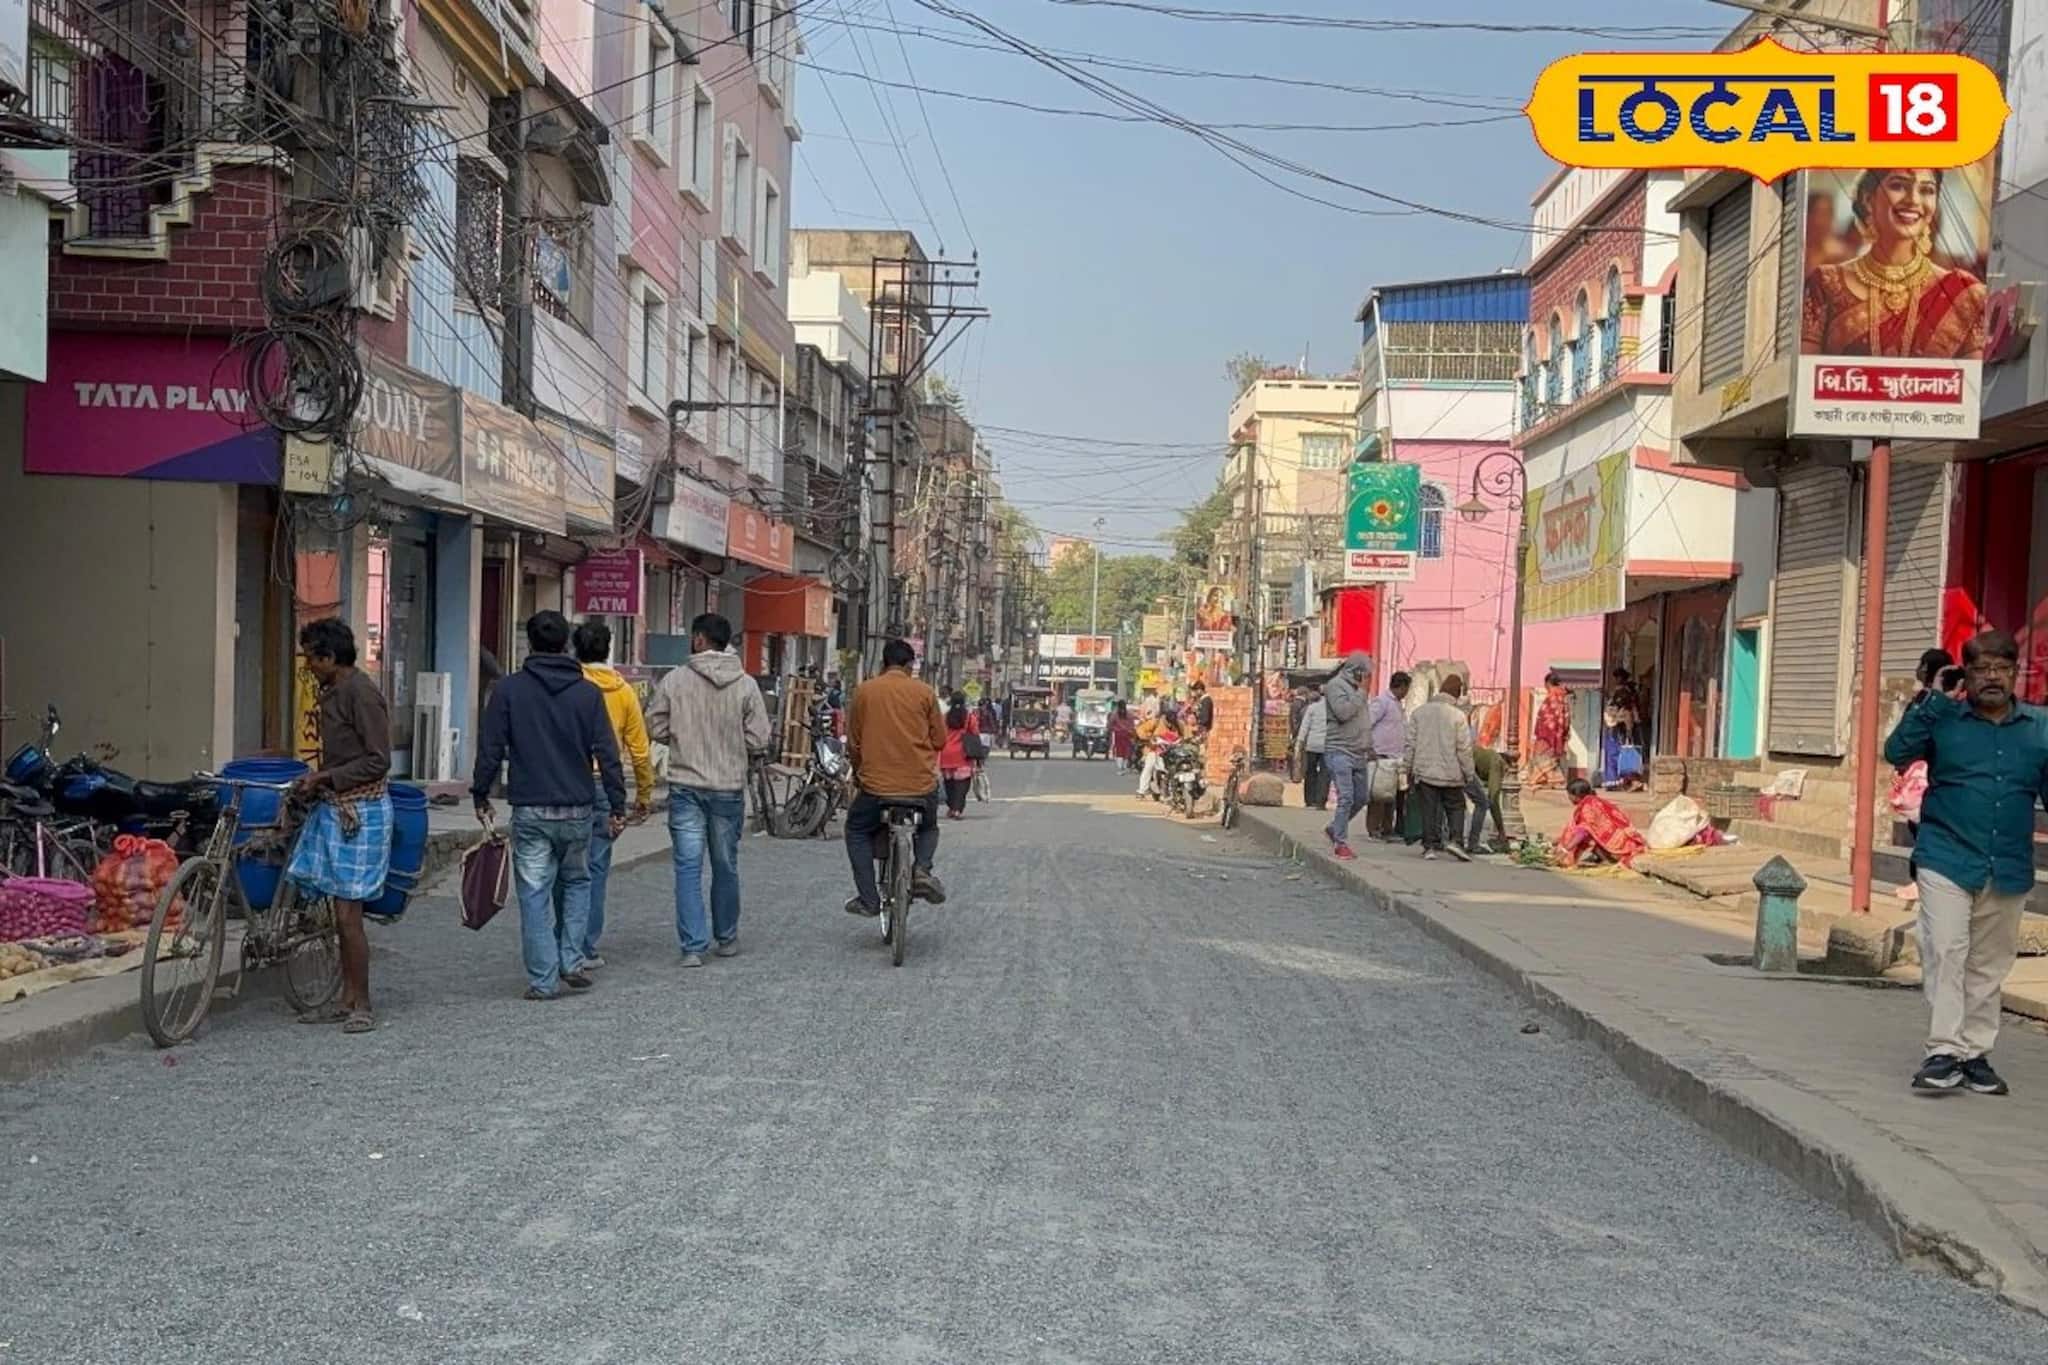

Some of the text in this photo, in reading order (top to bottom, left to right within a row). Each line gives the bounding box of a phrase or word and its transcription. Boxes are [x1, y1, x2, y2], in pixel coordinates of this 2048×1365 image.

[74, 382, 250, 413] TATA PLAY
[587, 596, 628, 612] ATM
